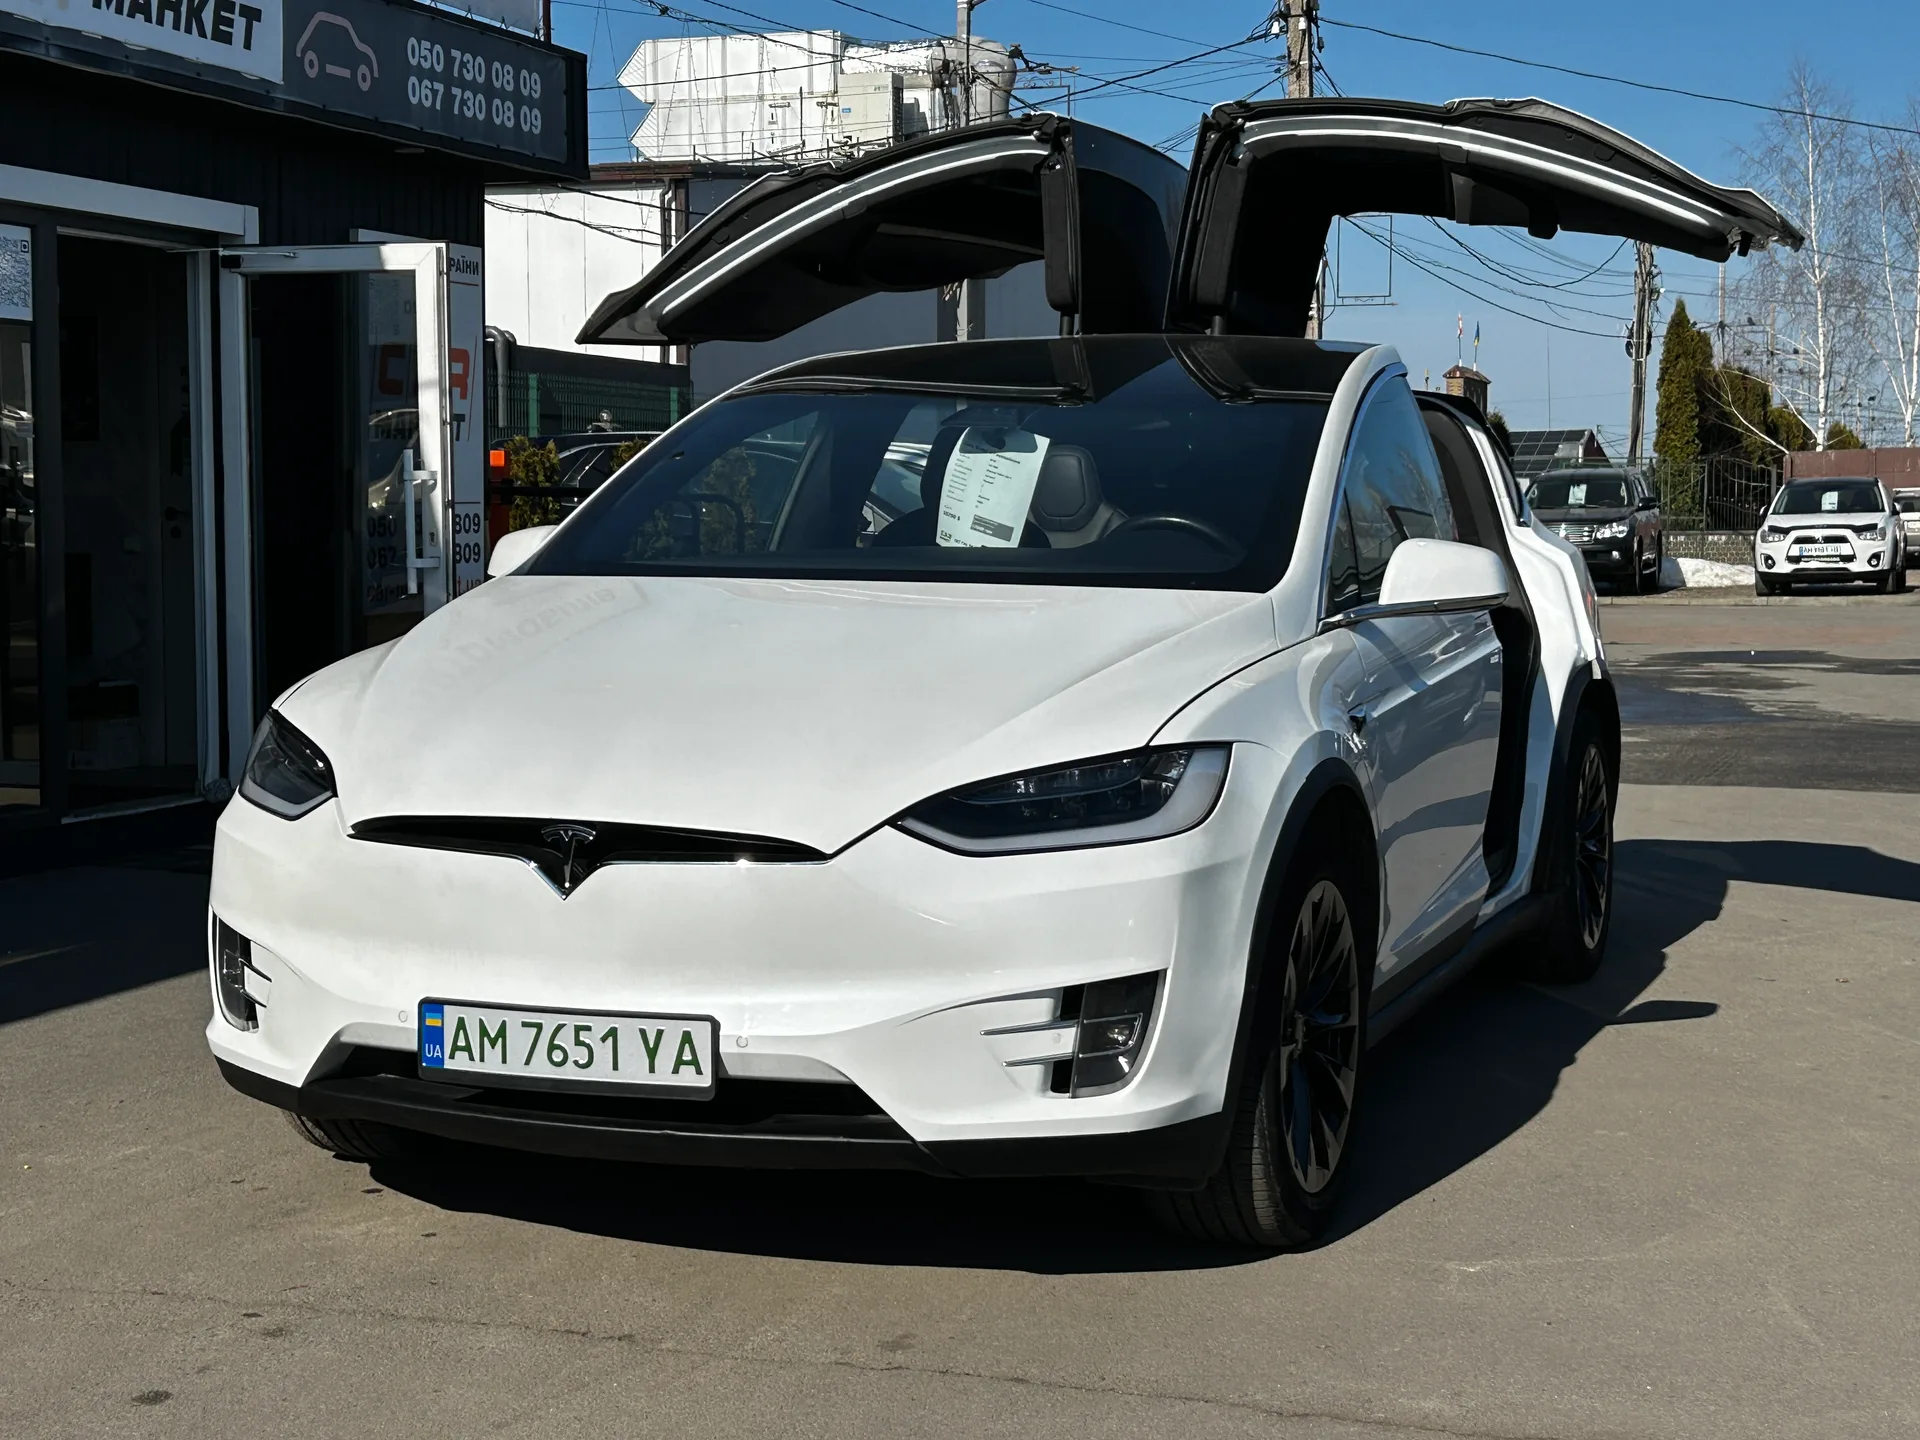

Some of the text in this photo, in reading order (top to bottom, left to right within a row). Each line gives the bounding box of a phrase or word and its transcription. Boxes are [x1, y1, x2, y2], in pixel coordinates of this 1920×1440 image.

[407, 36, 542, 99] 050 730 08 09
[407, 75, 542, 135] 067 730 08 09
[378, 344, 470, 400] CR
[425, 1043, 442, 1059] UA
[448, 1016, 704, 1076] AM 7651 YA
